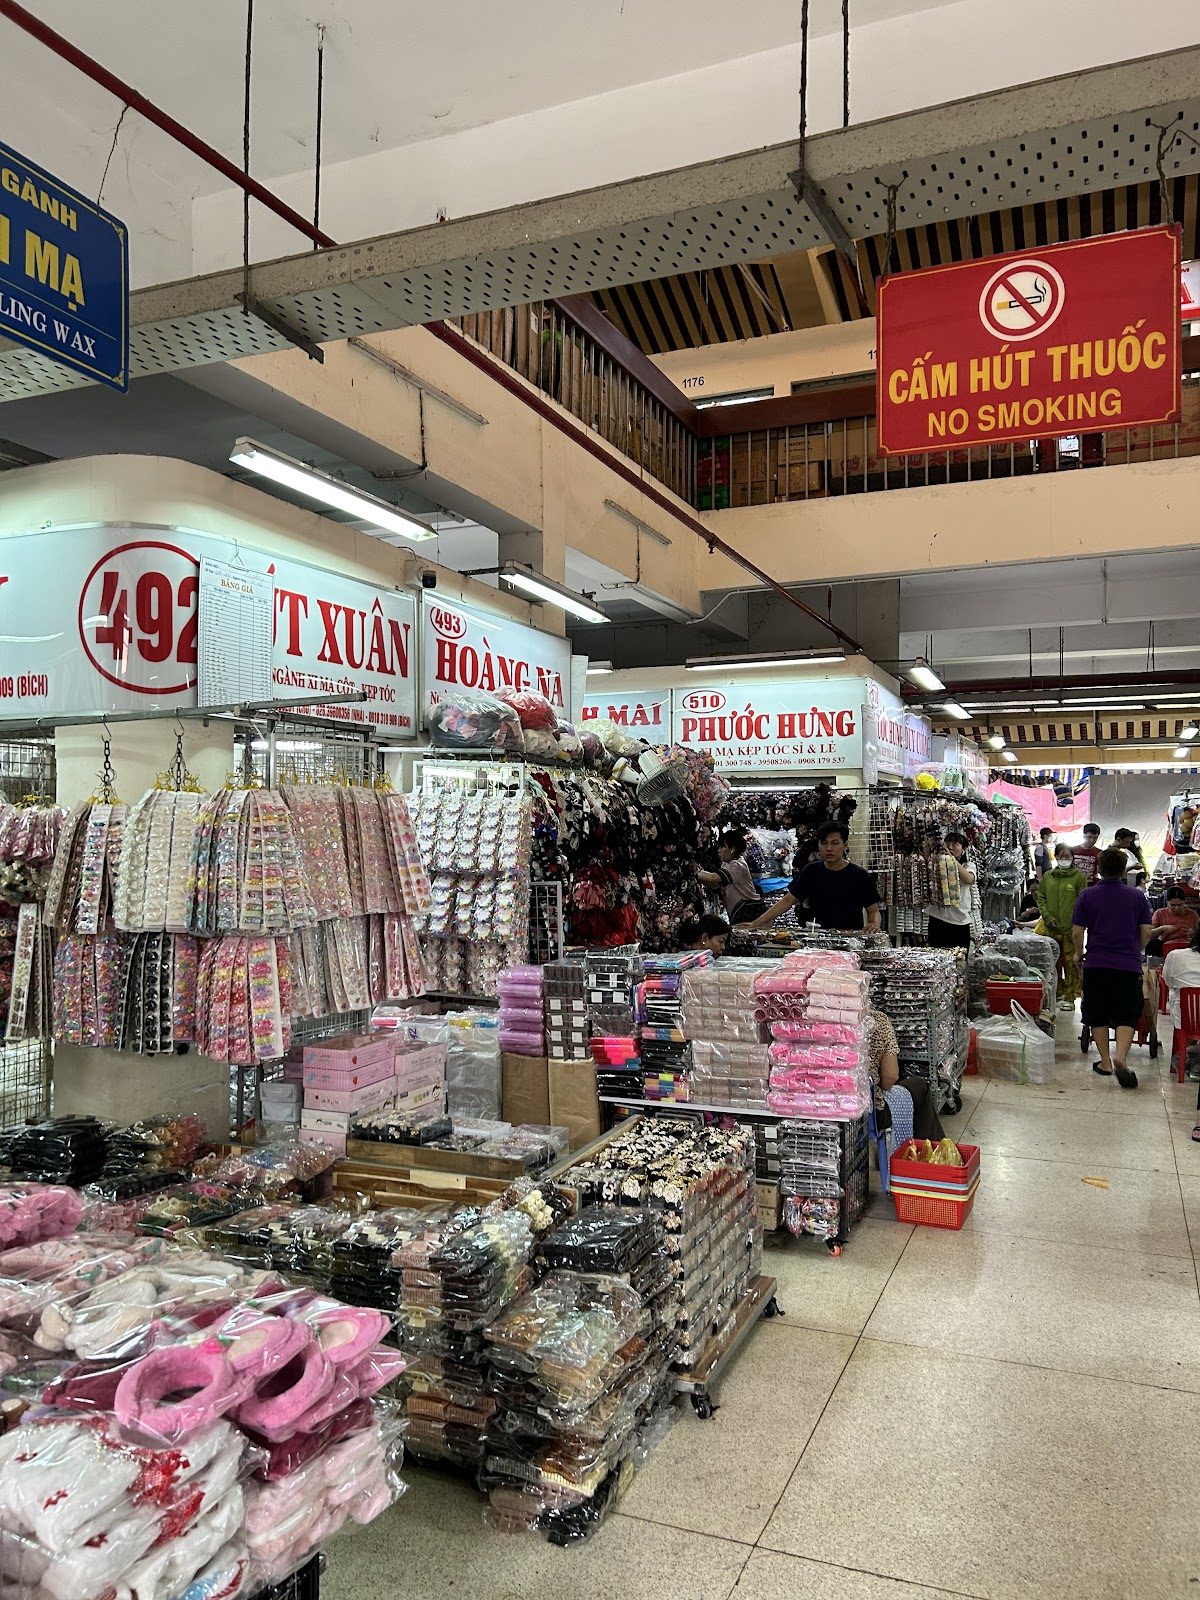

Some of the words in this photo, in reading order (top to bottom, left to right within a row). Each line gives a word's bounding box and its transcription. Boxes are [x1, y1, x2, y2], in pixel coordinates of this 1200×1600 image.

[25, 229, 85, 312] MẠ
[53, 319, 96, 359] WAX
[889, 351, 957, 404] CẤM
[969, 344, 1036, 393] HÚT
[1047, 319, 1167, 382] THUỐC
[682, 376, 705, 389] 1176
[928, 408, 970, 438] NO
[977, 388, 1122, 432] SMOKING
[95, 571, 198, 663] 492
[435, 608, 461, 633] 493
[317, 596, 410, 678] XUÂN
[435, 637, 531, 693] HOÀNG
[0, 676, 14, 697] 09
[17, 670, 48, 699] (BÍCH)
[379, 684, 396, 703] TÓC
[607, 703, 662, 726] MAI
[689, 695, 720, 709] 510
[682, 703, 770, 742] PHƯỚC
[777, 706, 856, 738] HƯNG
[715, 745, 733, 758] MẠ
[738, 745, 761, 758] KẸP
[763, 742, 790, 755] TÓC
[807, 744, 817, 754] &
[758, 758, 792, 766] 39508206
[798, 757, 816, 765] 0908
[832, 756, 846, 764] 537
